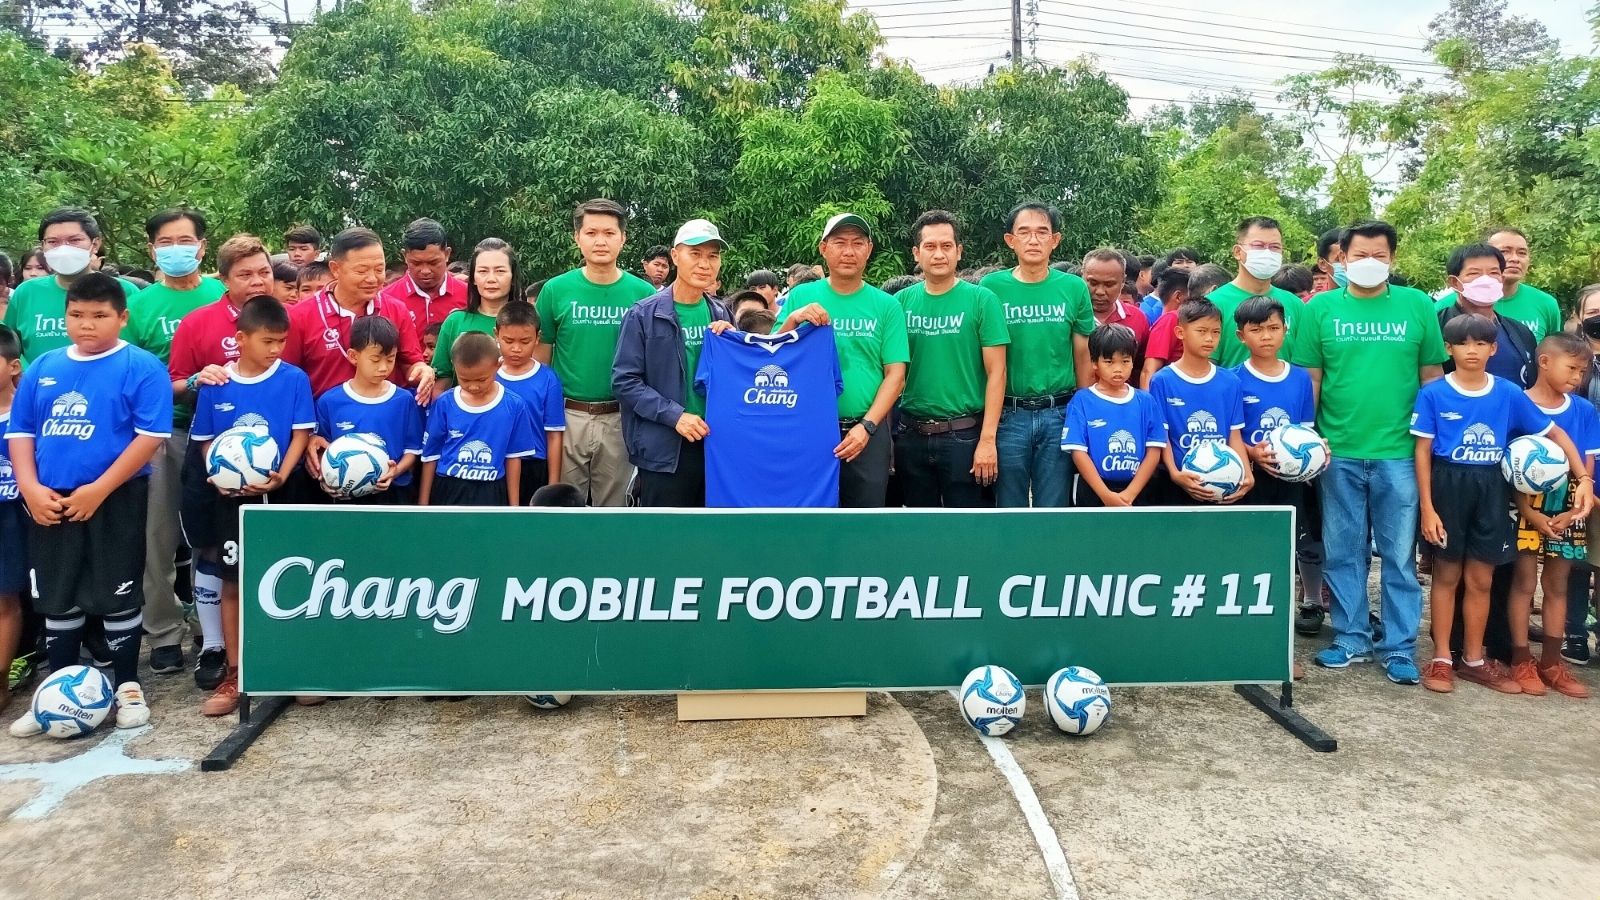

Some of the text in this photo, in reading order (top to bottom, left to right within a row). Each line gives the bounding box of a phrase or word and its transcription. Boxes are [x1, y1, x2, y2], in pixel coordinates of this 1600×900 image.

[1333, 318, 1408, 337] ไทยเบฟ
[743, 387, 799, 409] Chang
[41, 418, 96, 441] Chang
[257, 555, 480, 635] Chang
[500, 577, 704, 623] MOBILE
[716, 574, 984, 622] FOOTBALL
[999, 574, 1160, 617] CLINIC
[1214, 572, 1275, 617] 11
[57, 703, 94, 721] molten
[986, 706, 1018, 715] molten
